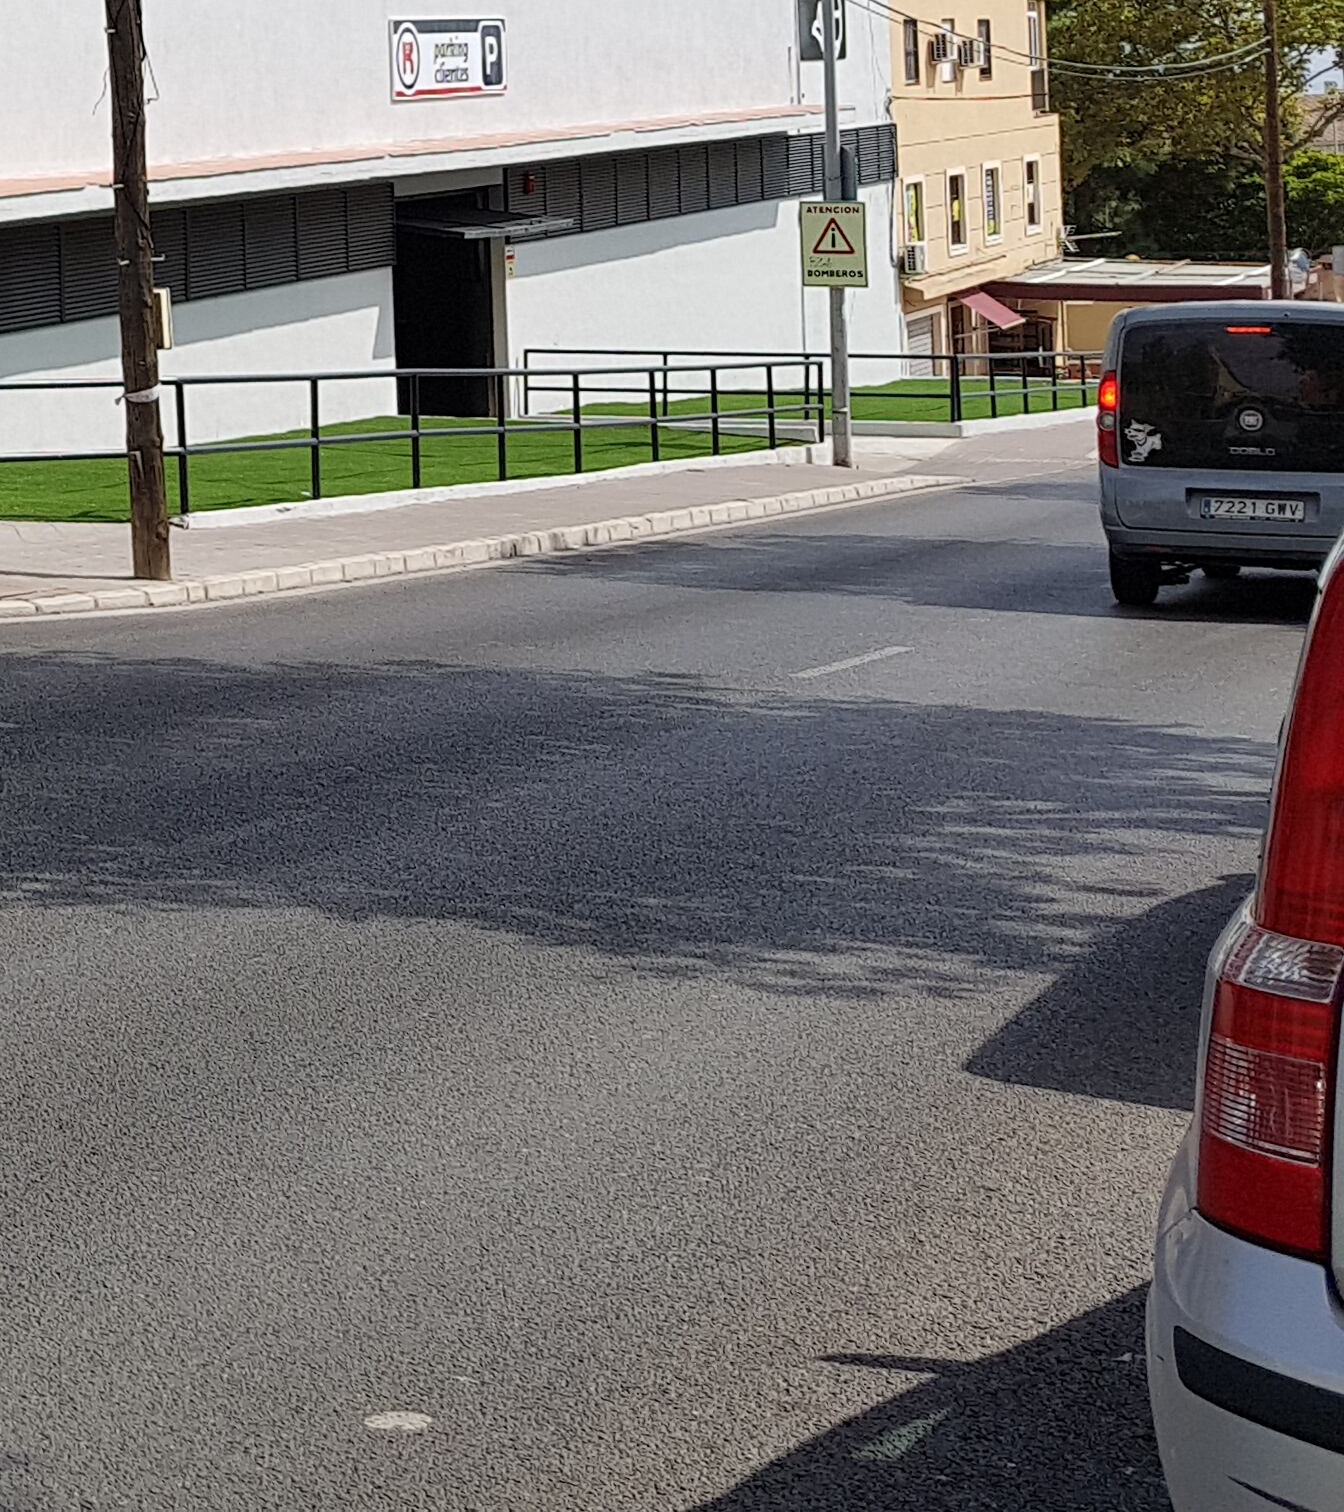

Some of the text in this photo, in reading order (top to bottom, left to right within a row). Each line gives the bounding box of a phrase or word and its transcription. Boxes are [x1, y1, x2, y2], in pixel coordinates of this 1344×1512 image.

[484, 35, 499, 76] P
[806, 206, 860, 214] ATENCION
[807, 269, 864, 278] BOMBEROS
[1214, 499, 1299, 516] 7221 GWV
